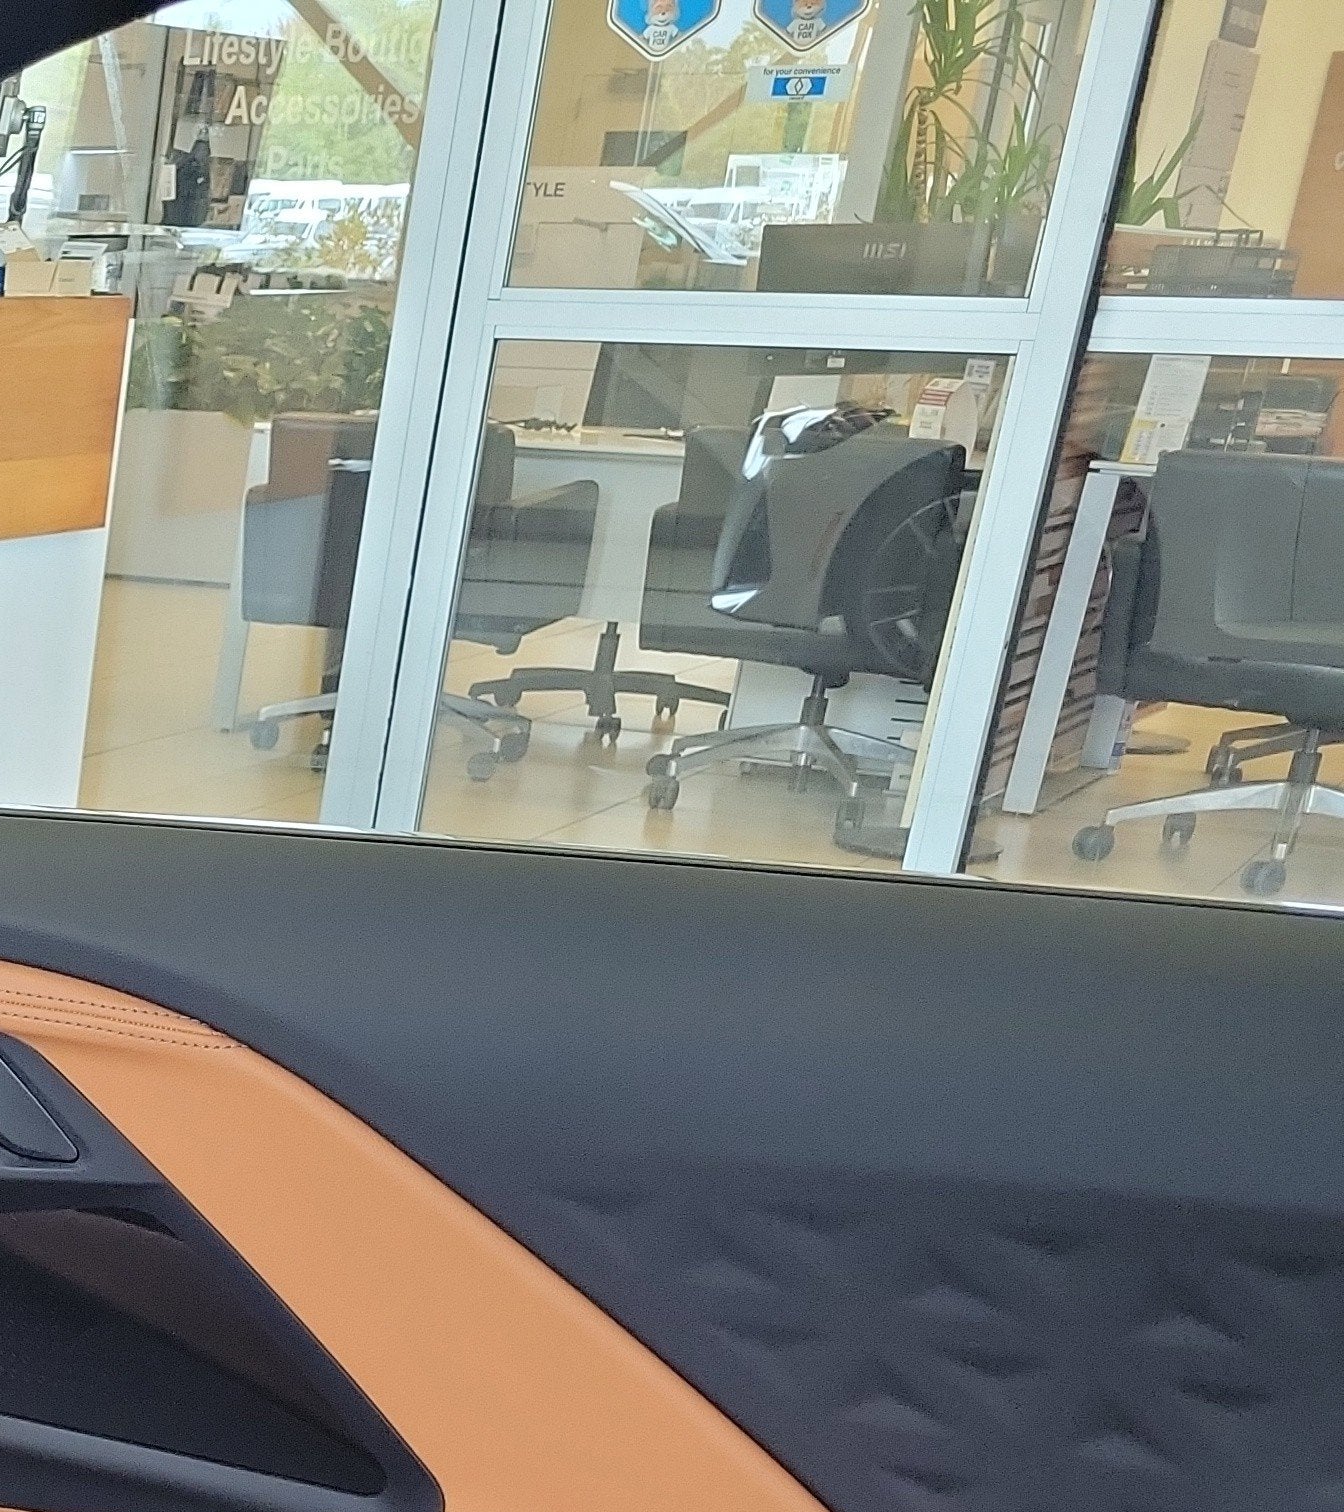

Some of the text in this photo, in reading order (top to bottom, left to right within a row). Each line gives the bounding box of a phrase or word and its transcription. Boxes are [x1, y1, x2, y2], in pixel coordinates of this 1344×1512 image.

[797, 23, 814, 32] CAR
[652, 30, 668, 39] CAR
[182, 26, 312, 76] Lifestyle
[763, 66, 841, 77] for your convenience
[224, 84, 422, 126] Accessories
[526, 182, 567, 198] YLE
